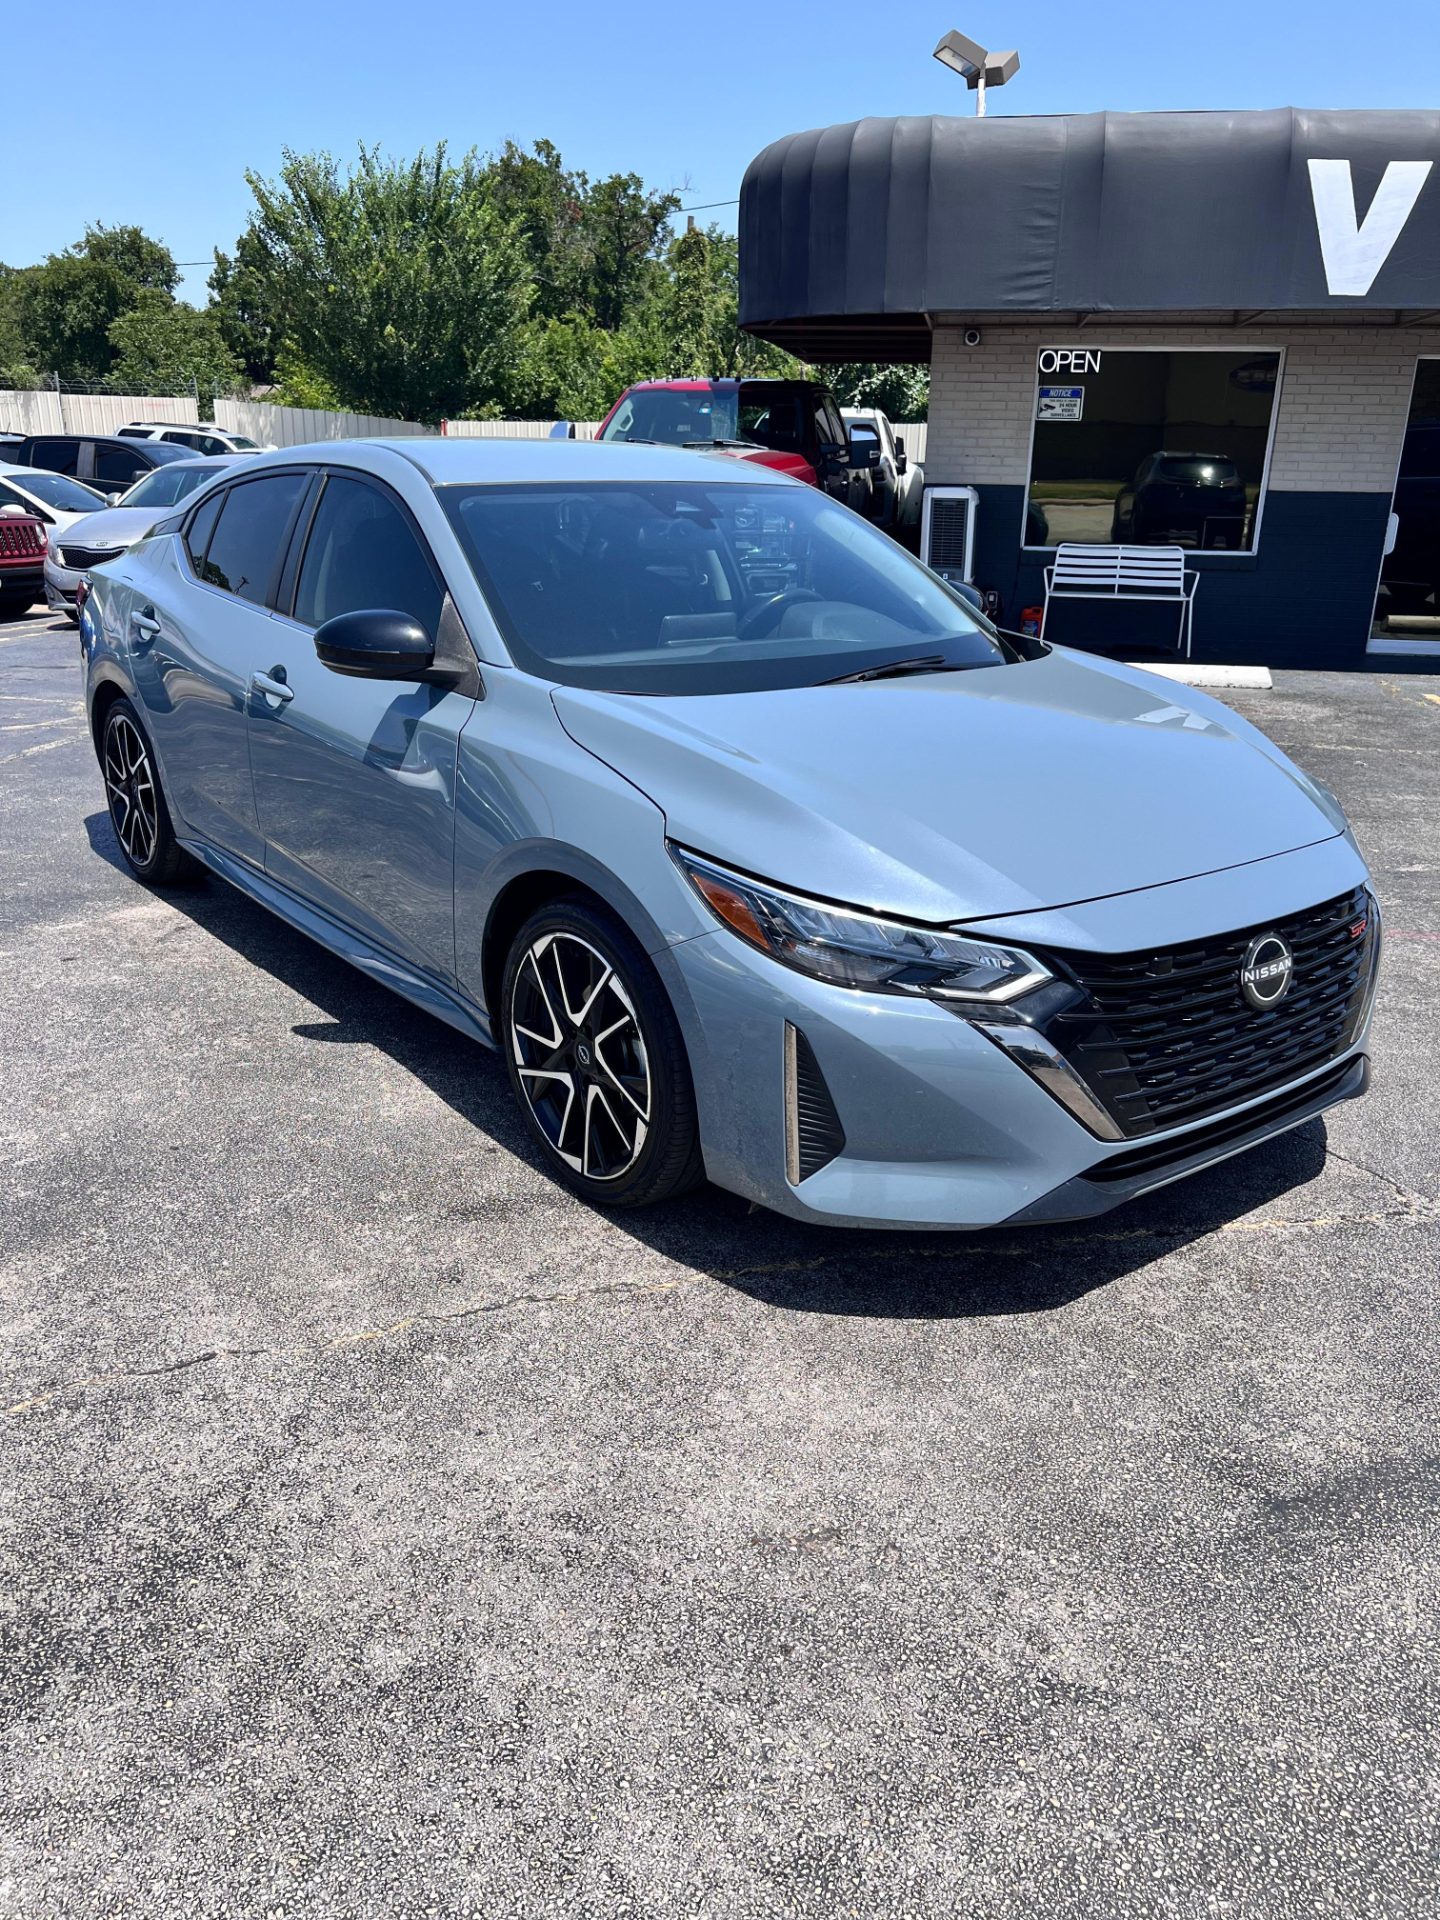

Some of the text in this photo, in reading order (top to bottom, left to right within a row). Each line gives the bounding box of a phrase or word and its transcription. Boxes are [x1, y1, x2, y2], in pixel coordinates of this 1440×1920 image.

[1307, 158, 1434, 296] V
[1040, 350, 1101, 373] OPEN
[1049, 389, 1072, 397] NOTICE
[1349, 919, 1367, 938] SR
[1244, 956, 1292, 982] NISSAN
